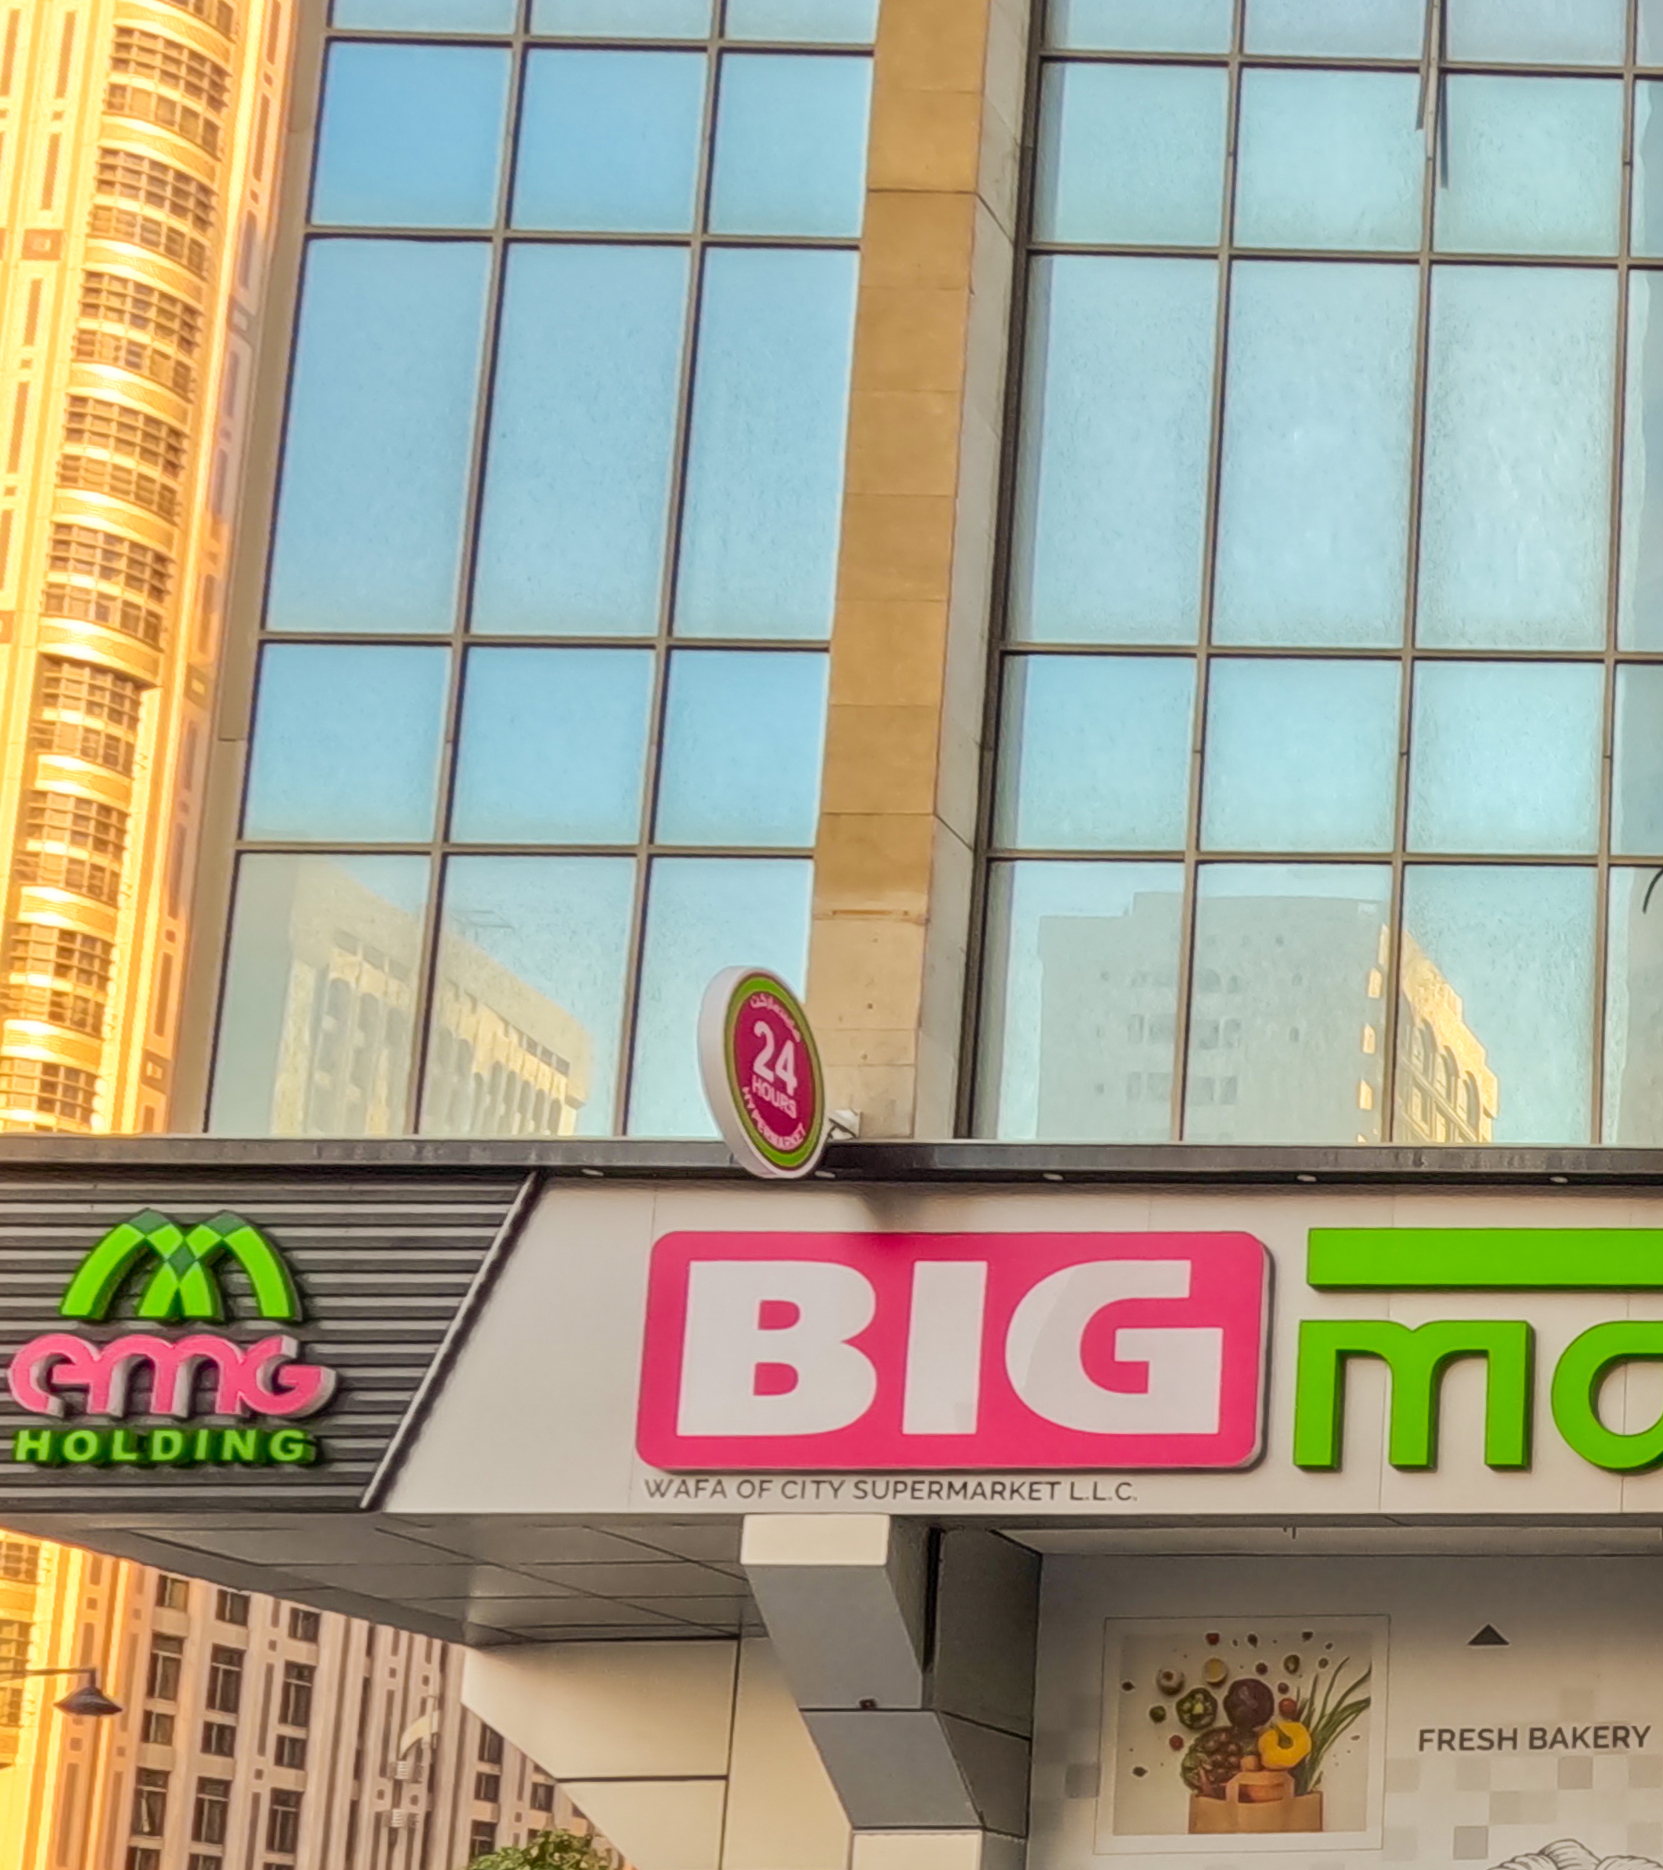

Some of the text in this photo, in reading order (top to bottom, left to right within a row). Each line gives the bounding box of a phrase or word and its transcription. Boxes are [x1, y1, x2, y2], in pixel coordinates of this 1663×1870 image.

[753, 1020, 798, 1097] 24
[751, 1074, 797, 1120] HOURS
[676, 1259, 1224, 1437] BIG
[14, 1429, 312, 1464] HOLDING
[644, 1479, 1139, 1501] WAFA OF CITY SUPERMARKET L.L.C.
[1418, 1725, 1652, 1752] FRESH BAKERY
